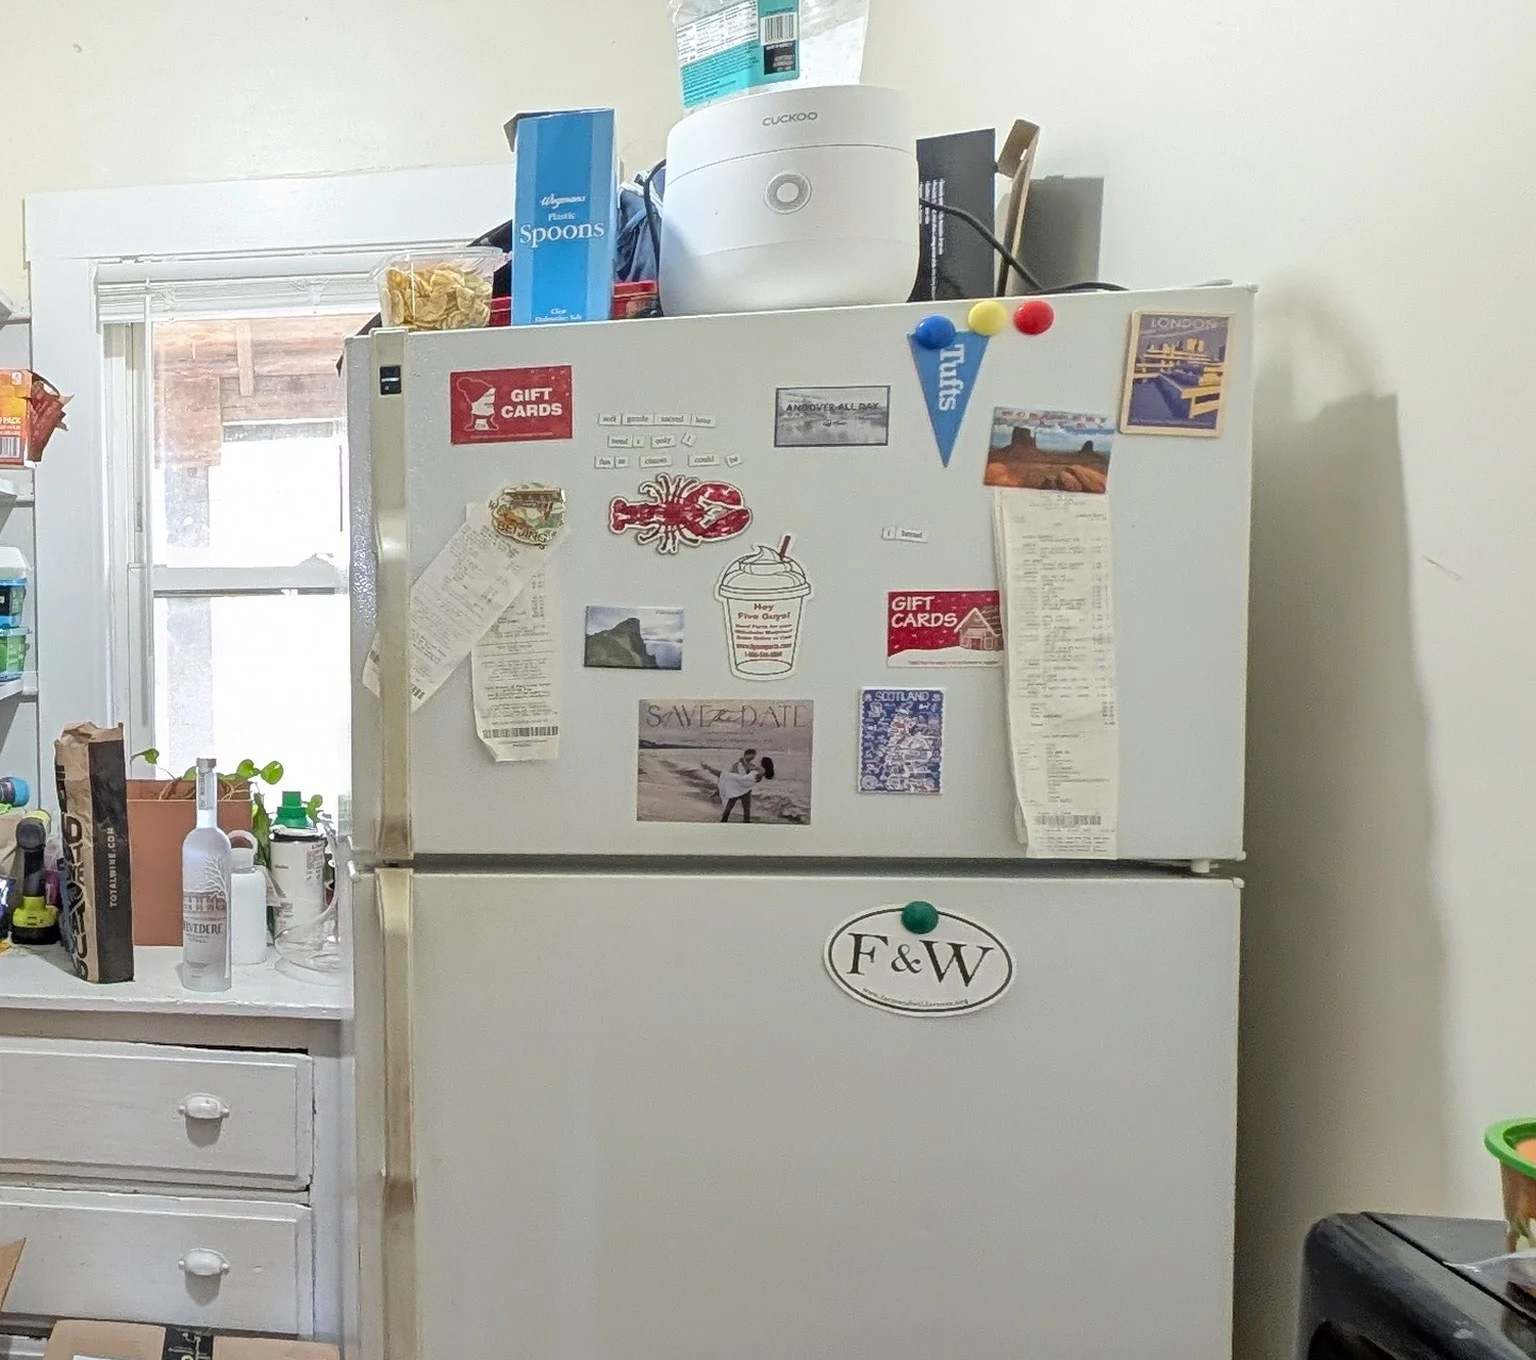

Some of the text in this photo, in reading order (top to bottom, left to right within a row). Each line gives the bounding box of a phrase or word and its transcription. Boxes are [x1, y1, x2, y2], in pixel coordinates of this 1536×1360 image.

[762, 110, 819, 128] CUCKOO
[539, 192, 587, 208] Wegmans
[547, 211, 577, 222] Plastic
[519, 221, 606, 249] Spoons
[1150, 317, 1218, 331] LONDON
[938, 344, 966, 412] Tufts
[510, 387, 554, 403] GIFT
[500, 402, 563, 418] CARDS
[891, 595, 935, 611] GIFT
[891, 612, 958, 629] CARDS
[874, 690, 930, 702] SCOTLAND
[645, 703, 708, 729] SAVE
[740, 704, 810, 729] DATE
[108, 826, 120, 908] TOTALWINE.COM
